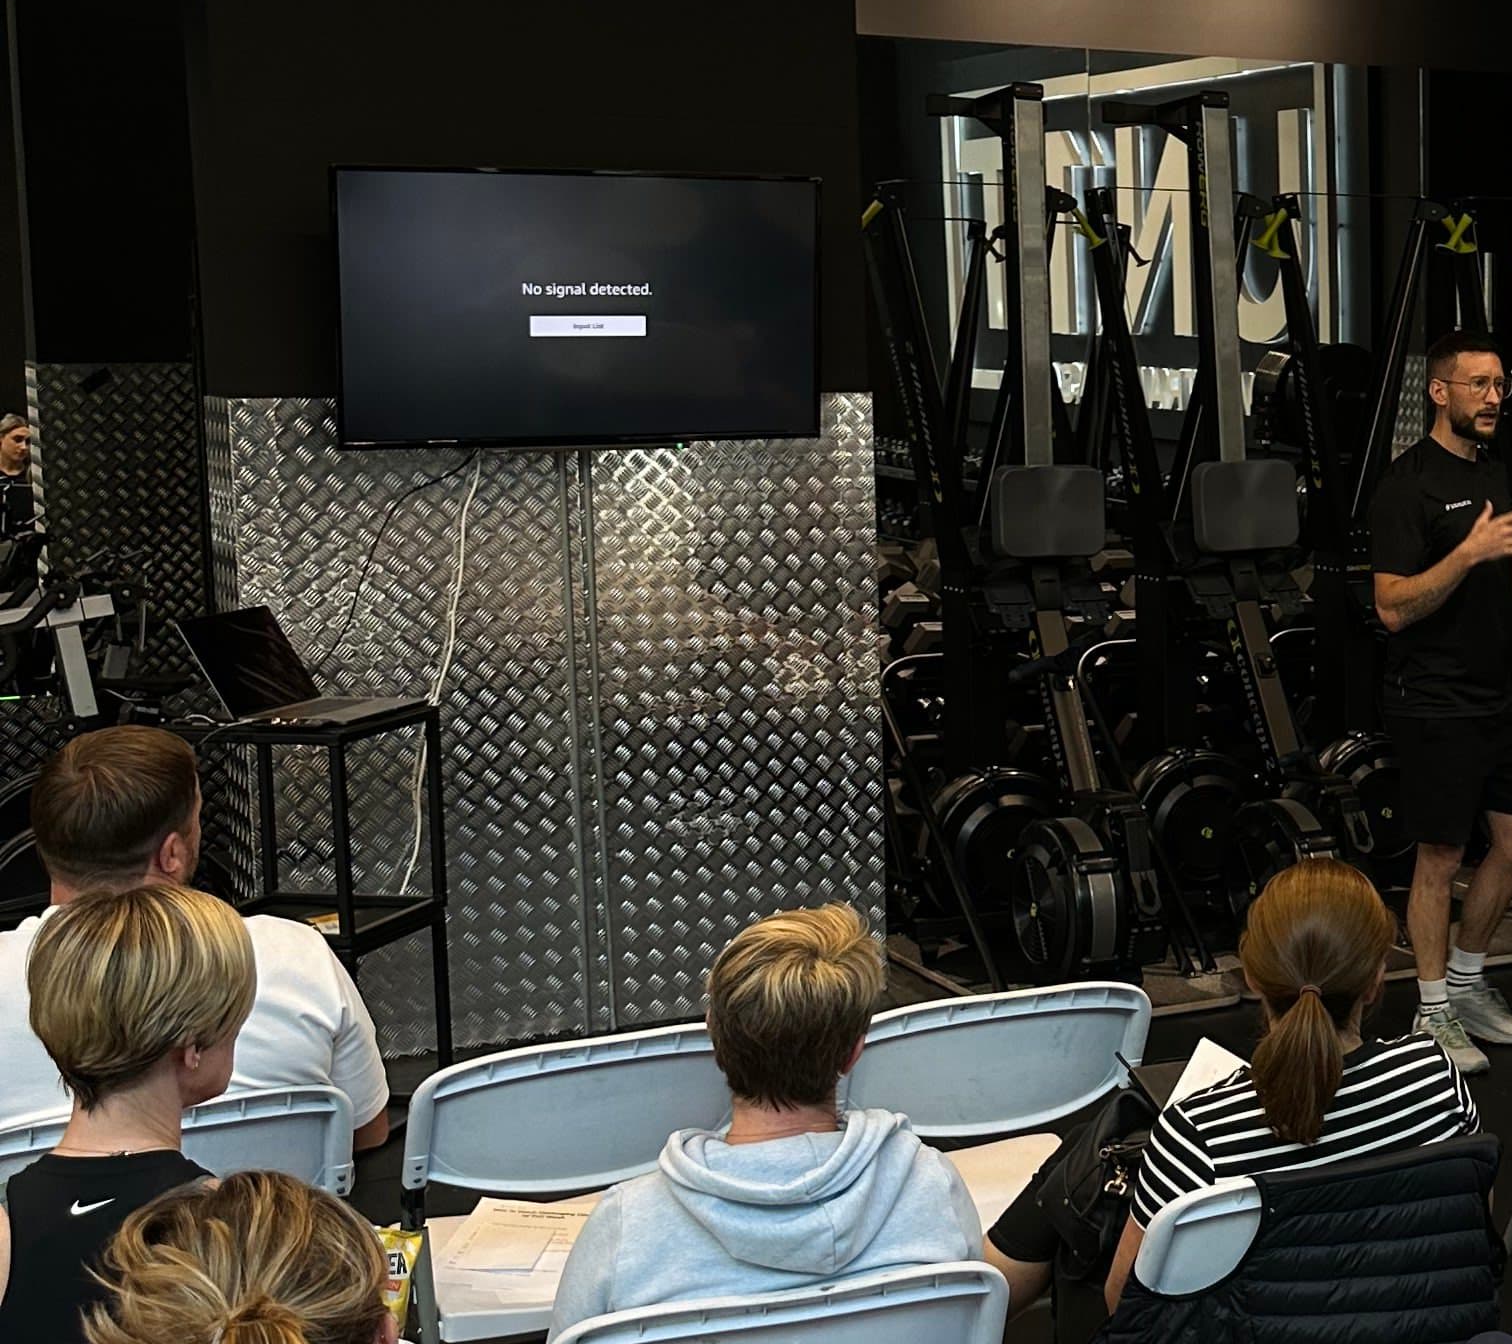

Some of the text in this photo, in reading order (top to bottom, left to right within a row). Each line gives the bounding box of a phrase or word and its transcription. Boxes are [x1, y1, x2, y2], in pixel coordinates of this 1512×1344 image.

[521, 282, 653, 299] No signal detected.
